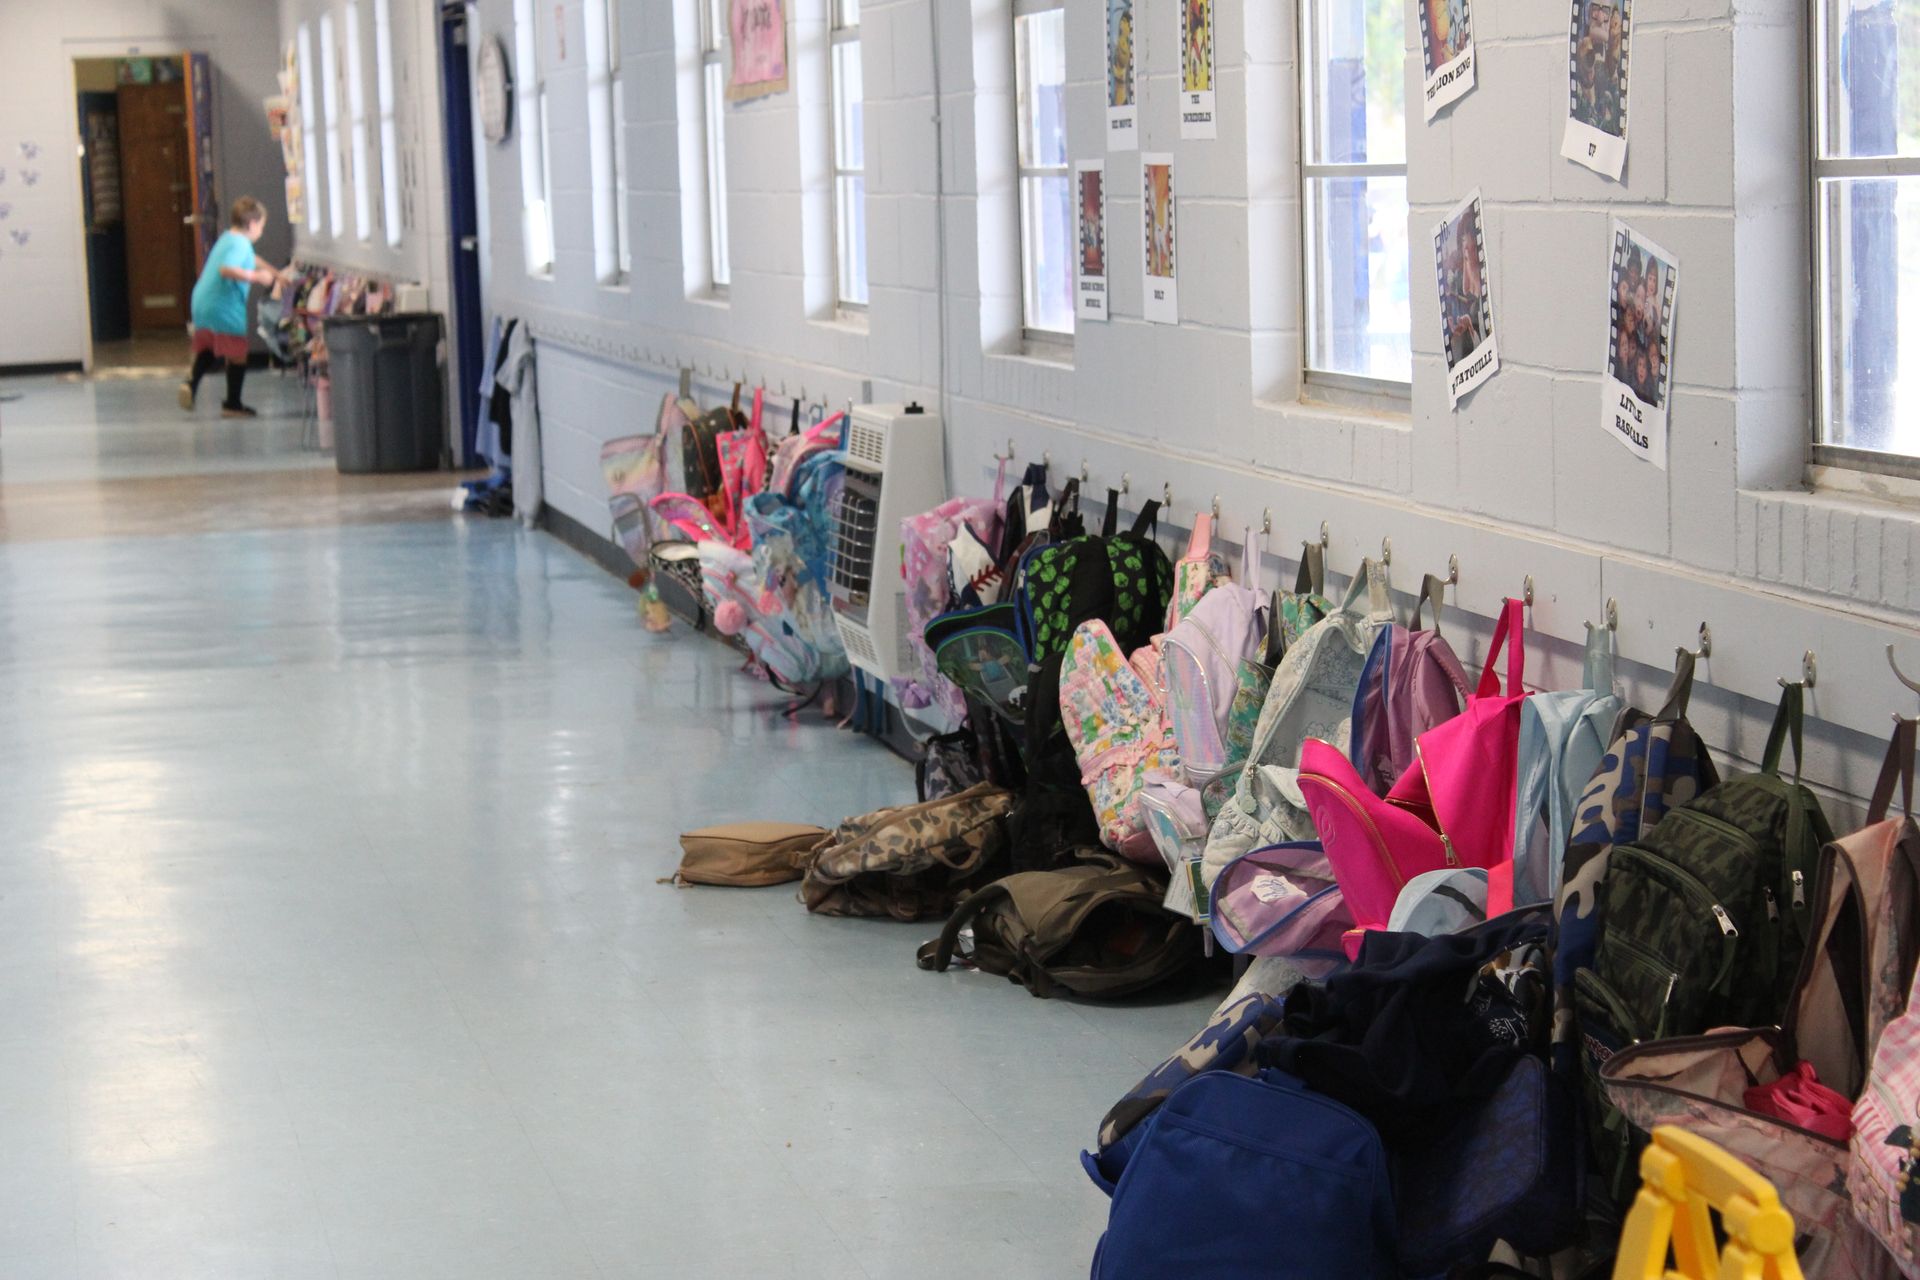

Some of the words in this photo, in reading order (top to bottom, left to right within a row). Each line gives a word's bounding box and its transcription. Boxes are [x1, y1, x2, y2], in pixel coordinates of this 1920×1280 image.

[1436, 69, 1455, 91] LION
[1455, 56, 1471, 80] KING
[1588, 142, 1597, 158] UP
[1452, 349, 1492, 395] TATOUILLE
[1620, 393, 1642, 423] LITTLE
[1615, 414, 1649, 449] RASCALS
